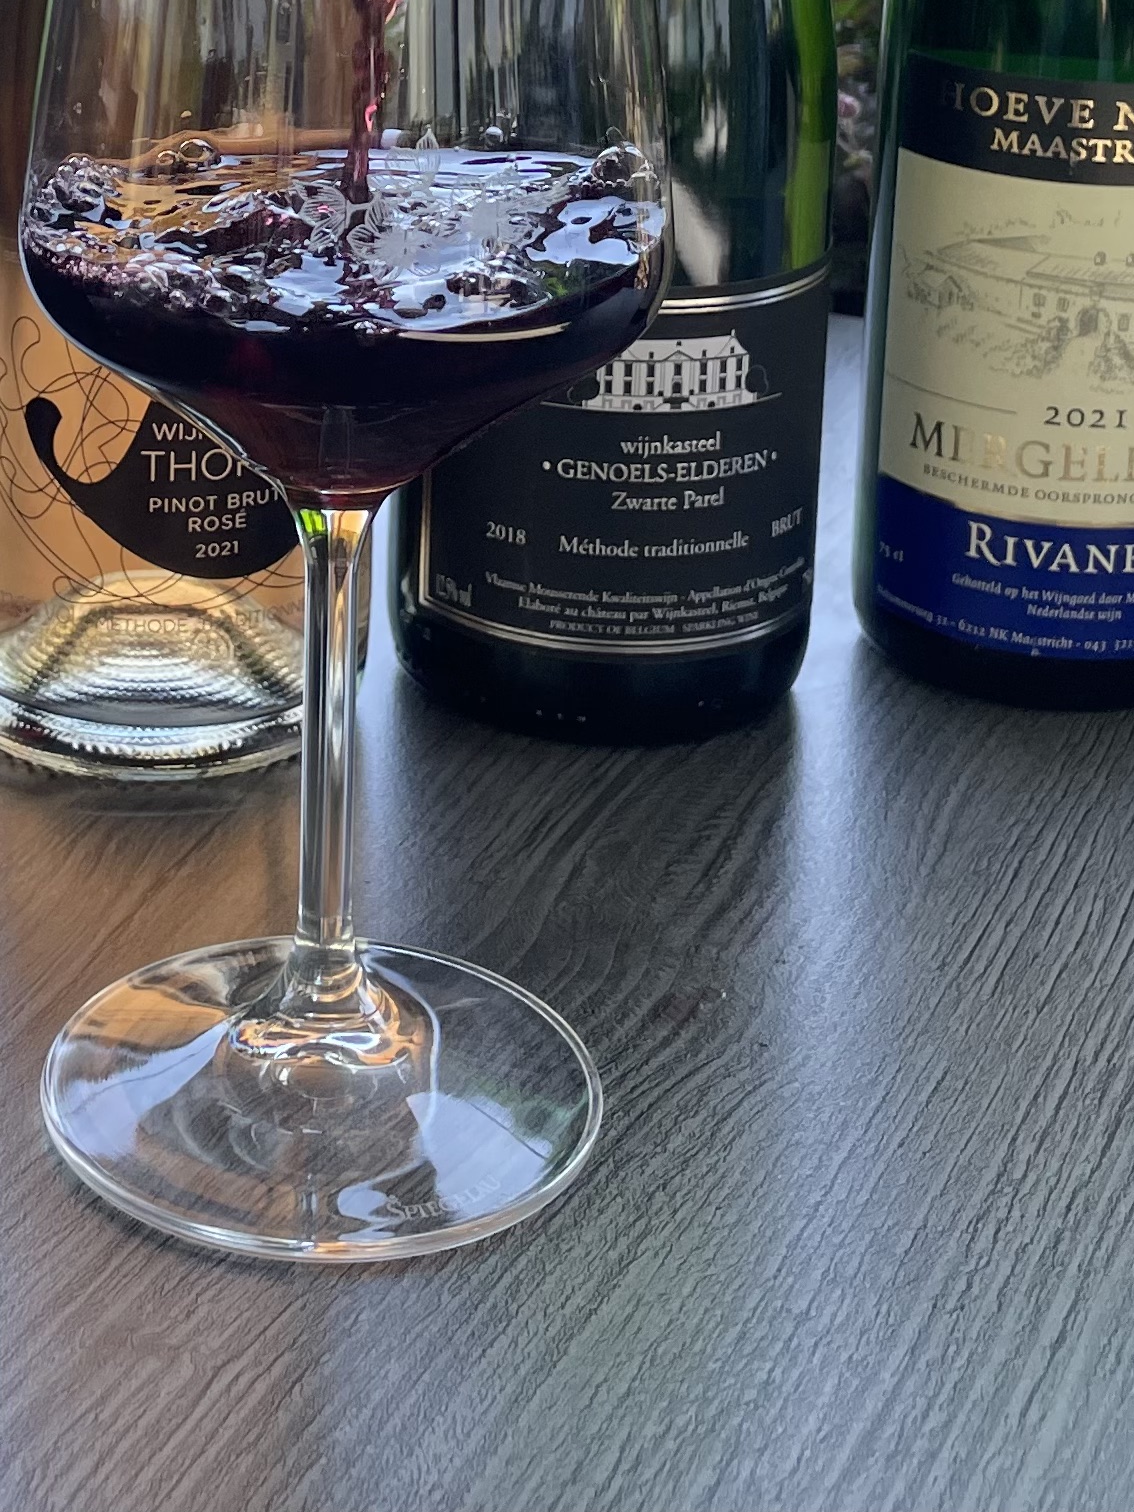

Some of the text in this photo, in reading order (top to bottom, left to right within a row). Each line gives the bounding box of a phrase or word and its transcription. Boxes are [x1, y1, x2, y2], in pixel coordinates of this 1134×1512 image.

[1043, 405, 1129, 429] 2021
[620, 431, 722, 459] wijnkasteel
[556, 449, 770, 484] GENOELS-ELDEREN
[149, 495, 218, 513] PINOT
[610, 486, 725, 512] Zwarte Parel
[187, 508, 248, 533] ROSÉ
[485, 520, 528, 546] 2018
[770, 508, 804, 538] BRUT
[195, 540, 239, 559] 2021
[557, 531, 751, 559] Méthode traditionnelle
[1098, 609, 1122, 622] wijn
